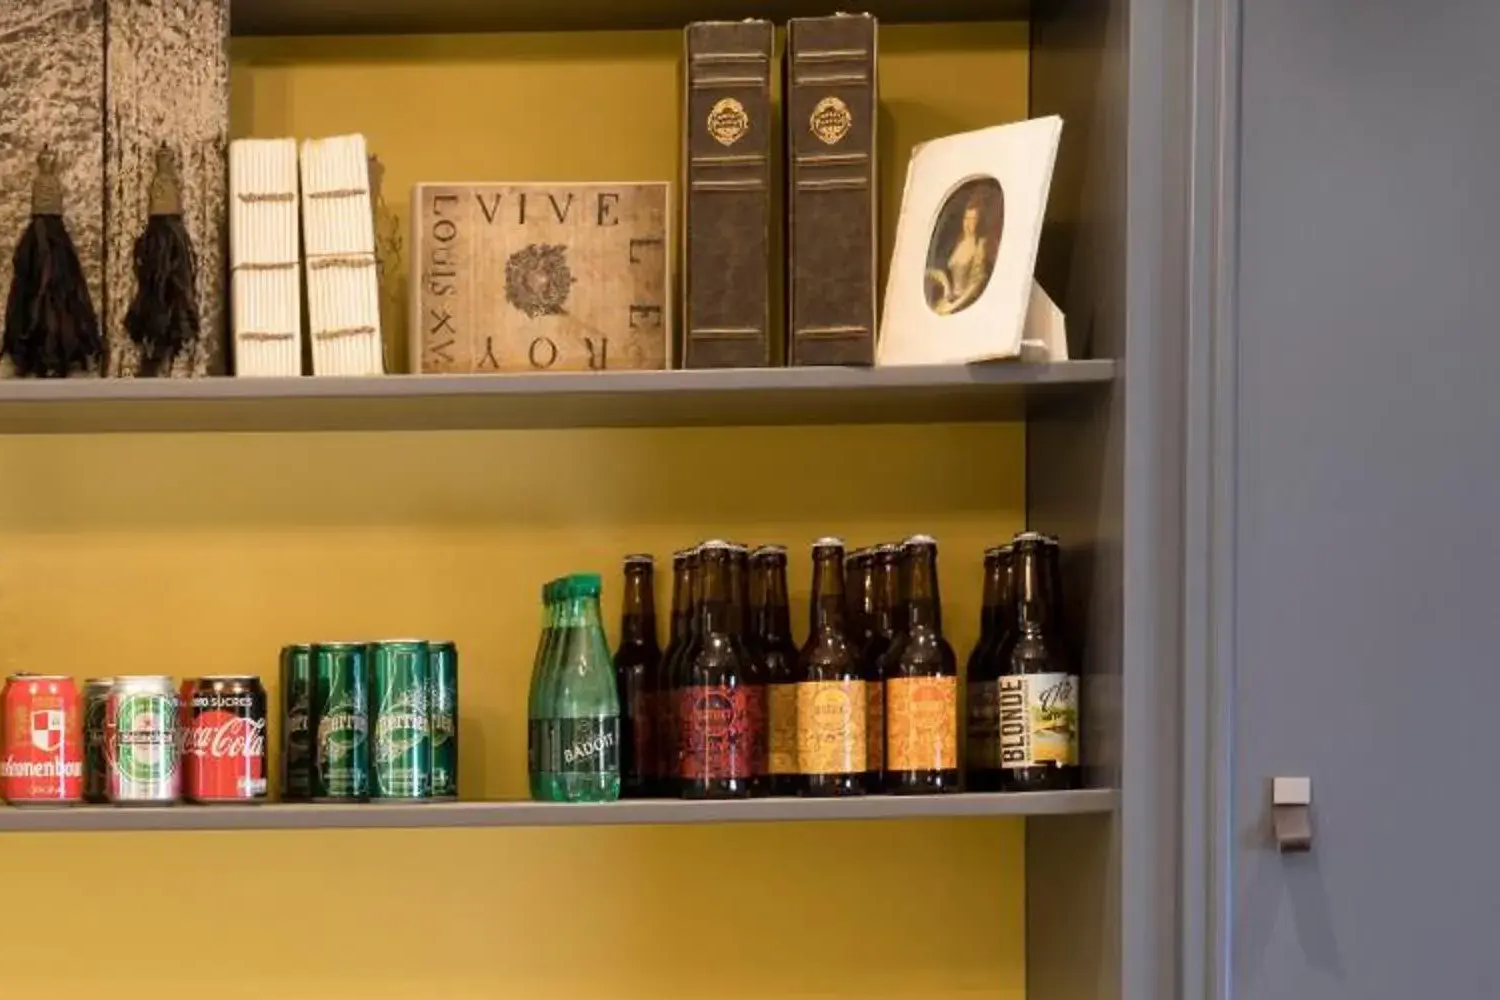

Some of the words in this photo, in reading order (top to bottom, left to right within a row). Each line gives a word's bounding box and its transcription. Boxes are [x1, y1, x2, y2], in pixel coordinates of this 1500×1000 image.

[475, 192, 620, 227] VIVE
[428, 194, 458, 297] LOUIS
[476, 335, 609, 370] ROY
[1001, 679, 1025, 763] BLONDE
[563, 732, 614, 764] BADOIT
